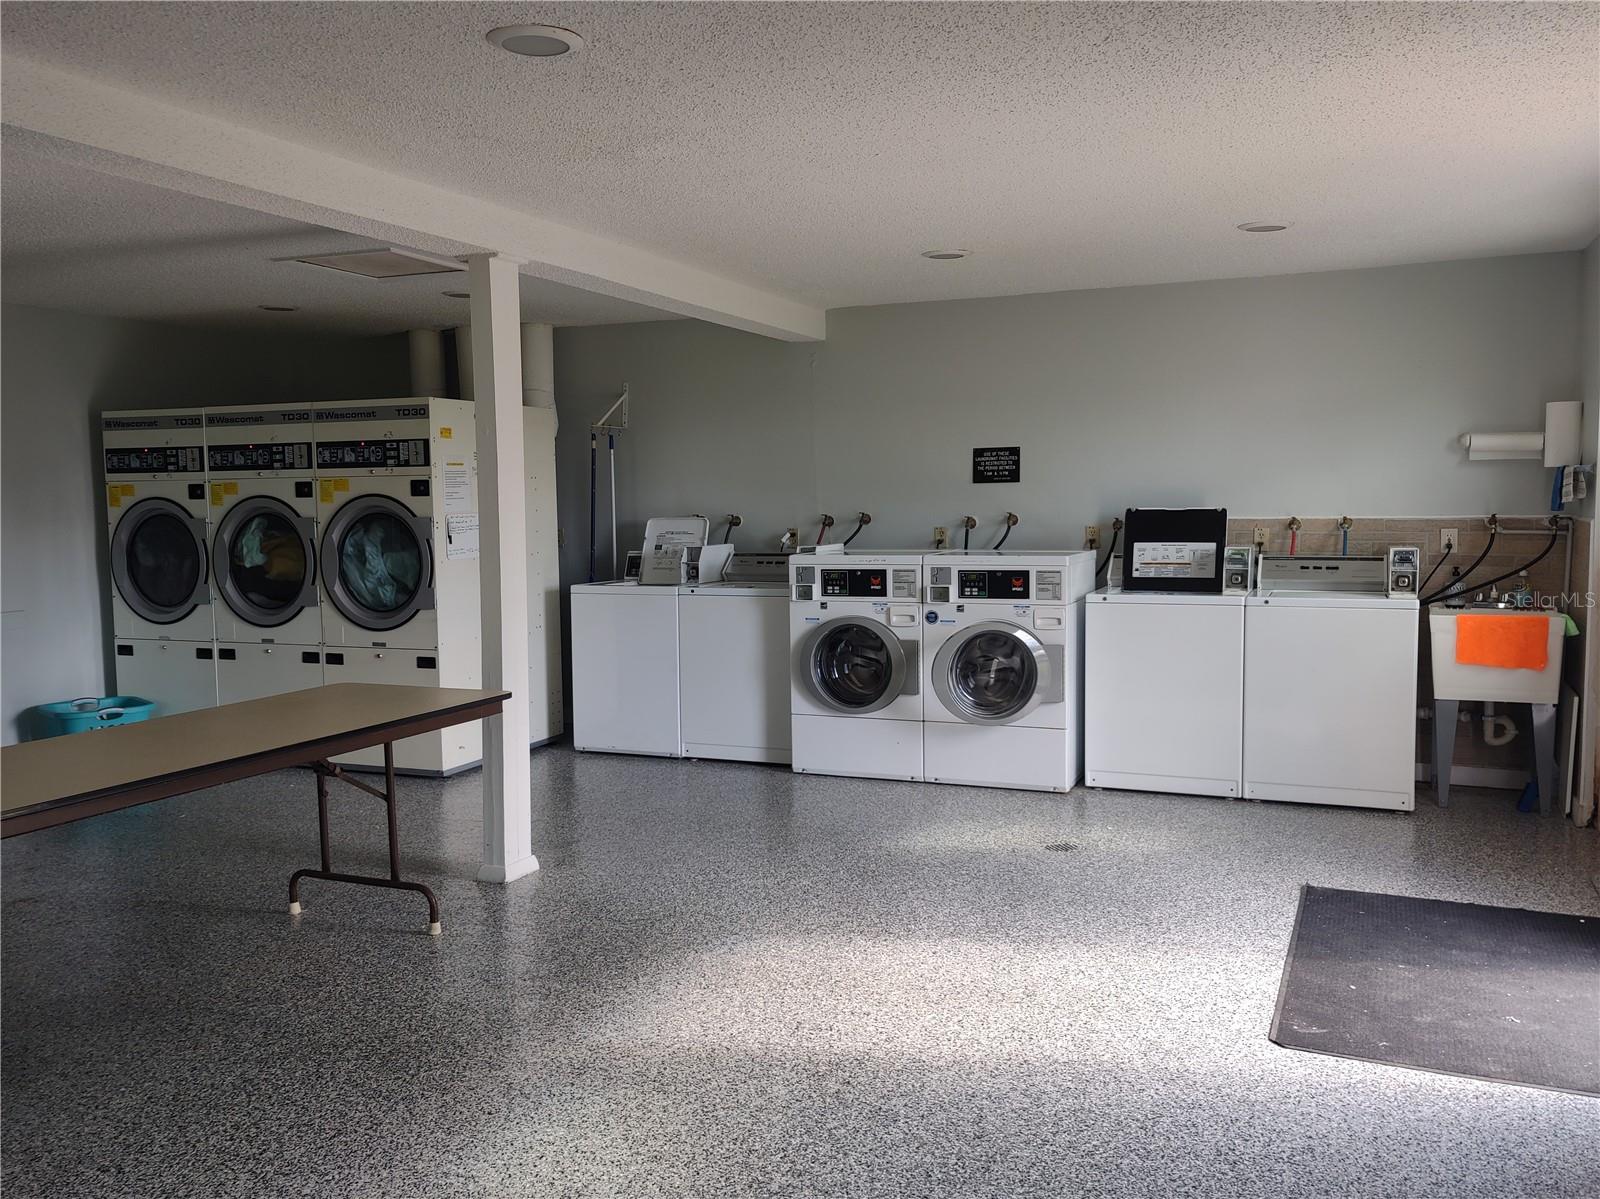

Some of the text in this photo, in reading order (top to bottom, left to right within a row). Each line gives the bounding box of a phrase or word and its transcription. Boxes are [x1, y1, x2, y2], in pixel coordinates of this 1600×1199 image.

[281, 412, 310, 421] TD30
[324, 410, 376, 420] Wascomat
[395, 408, 426, 417] TD30
[112, 420, 159, 428] Wascomat
[174, 418, 201, 426] TD30
[215, 415, 265, 424] Wascomat
